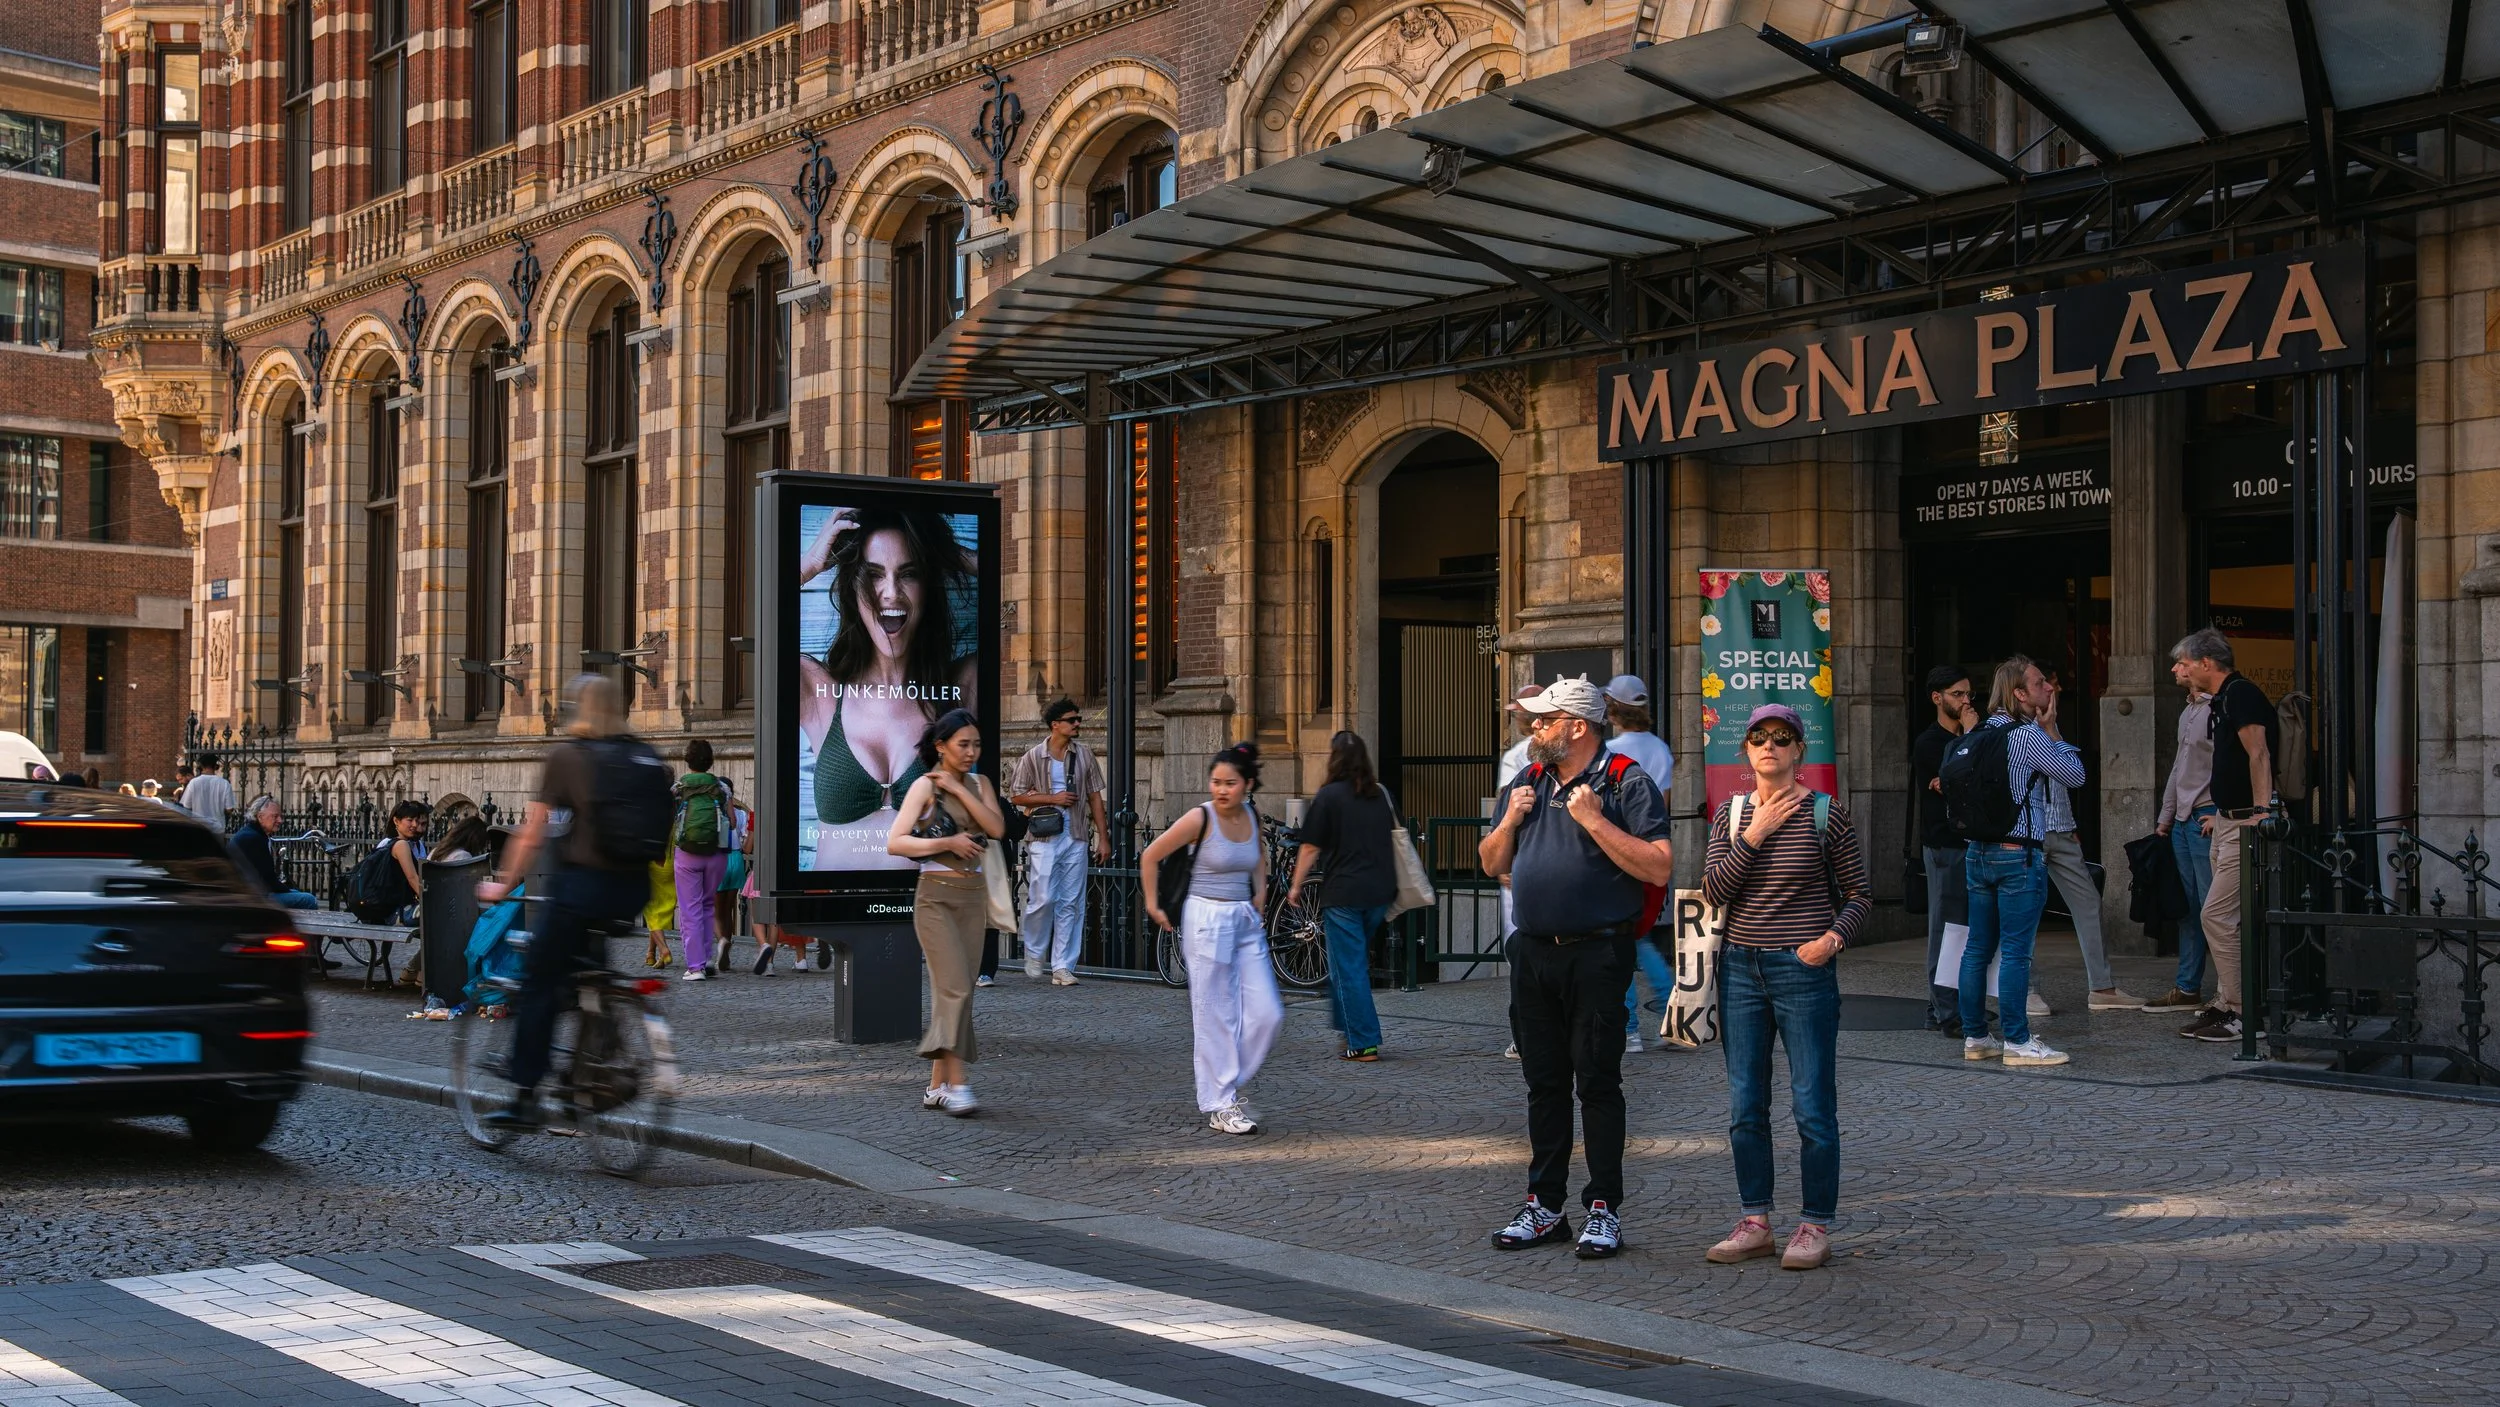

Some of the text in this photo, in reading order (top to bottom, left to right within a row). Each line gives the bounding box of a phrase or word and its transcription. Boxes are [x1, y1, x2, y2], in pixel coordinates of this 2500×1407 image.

[1606, 261, 2348, 449] MAGNA PLAZA
[1937, 469, 2093, 501] OPEN 7 DAYS A WEEK
[2232, 477, 2278, 498] 10.00
[1916, 487, 2111, 523] THE BEST STORES IN TOWN
[1756, 604, 1775, 621] M
[1719, 651, 1816, 668] SPECIAL
[1730, 672, 1807, 690] OFFER
[816, 680, 961, 700] HUNKEMÖLLER
[1725, 704, 1748, 712] HERE
[807, 826, 828, 839] for
[832, 829, 871, 841] every
[852, 845, 869, 853] with
[866, 904, 914, 914] JCDecaux
